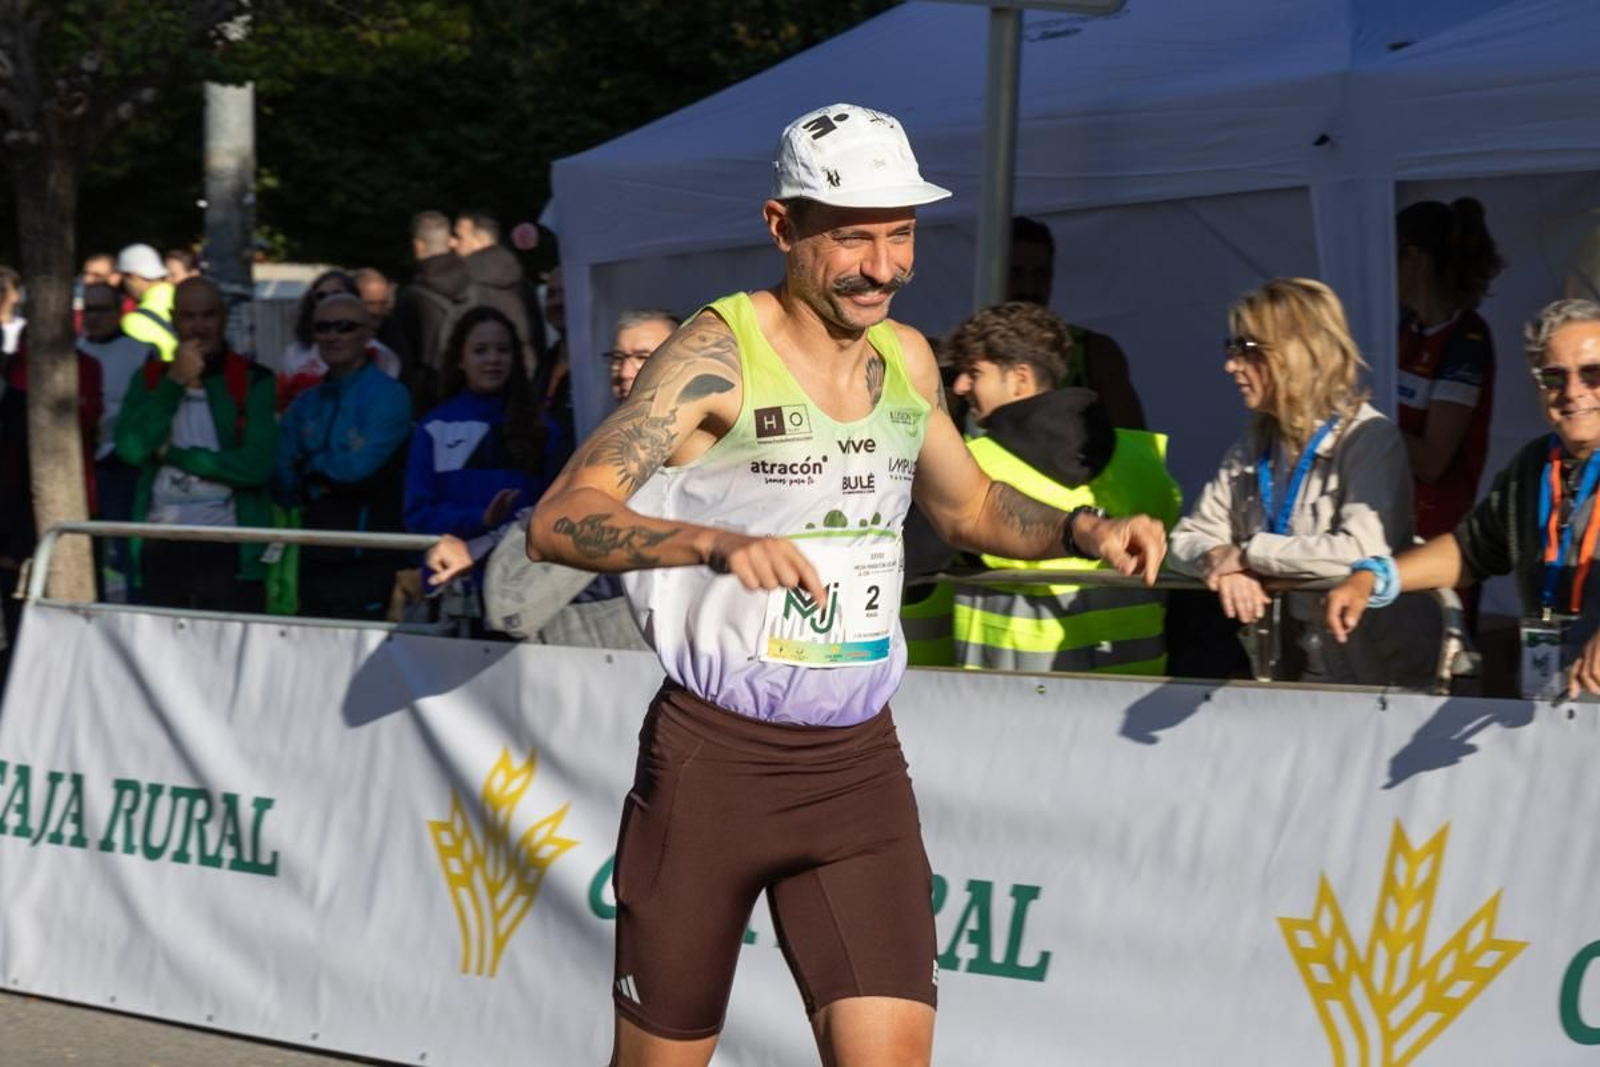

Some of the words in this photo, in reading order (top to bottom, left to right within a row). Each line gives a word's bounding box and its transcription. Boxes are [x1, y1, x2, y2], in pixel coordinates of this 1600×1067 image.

[837, 436, 876, 454] vive
[750, 456, 823, 475] atracón
[865, 585, 880, 611] 2
[0, 760, 88, 848] AJA
[98, 778, 279, 877] RURAL
